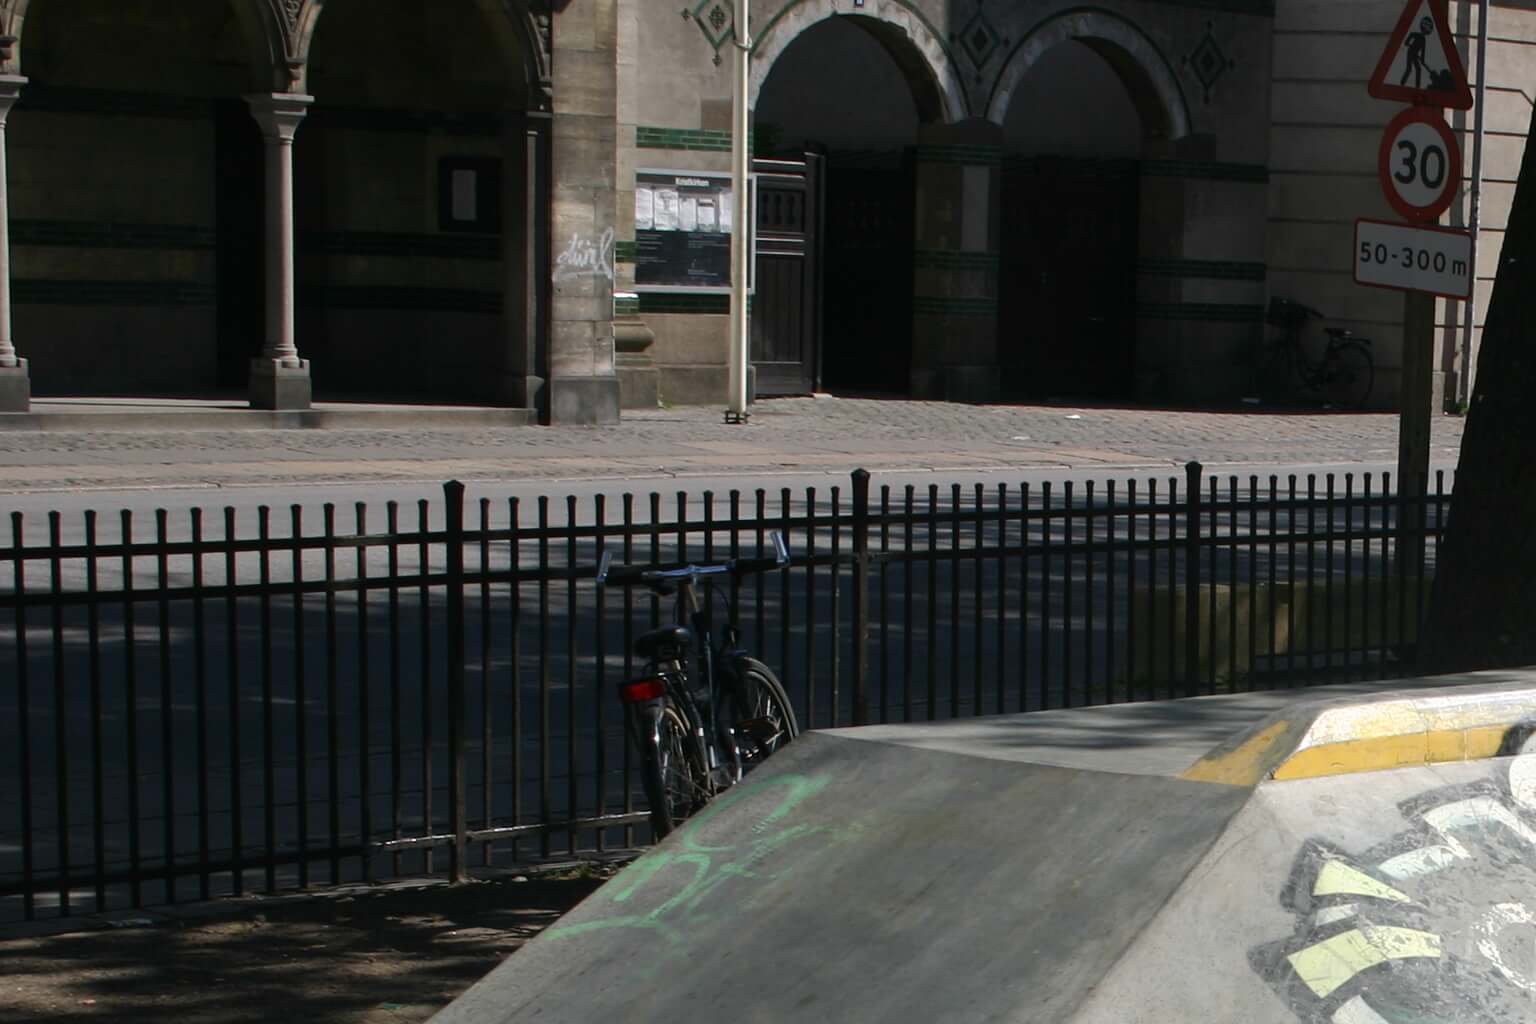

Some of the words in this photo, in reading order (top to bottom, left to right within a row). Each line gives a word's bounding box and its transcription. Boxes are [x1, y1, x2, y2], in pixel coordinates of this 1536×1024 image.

[1394, 140, 1446, 190] 30
[1359, 241, 1446, 274] 50-300
[1452, 258, 1467, 277] m
